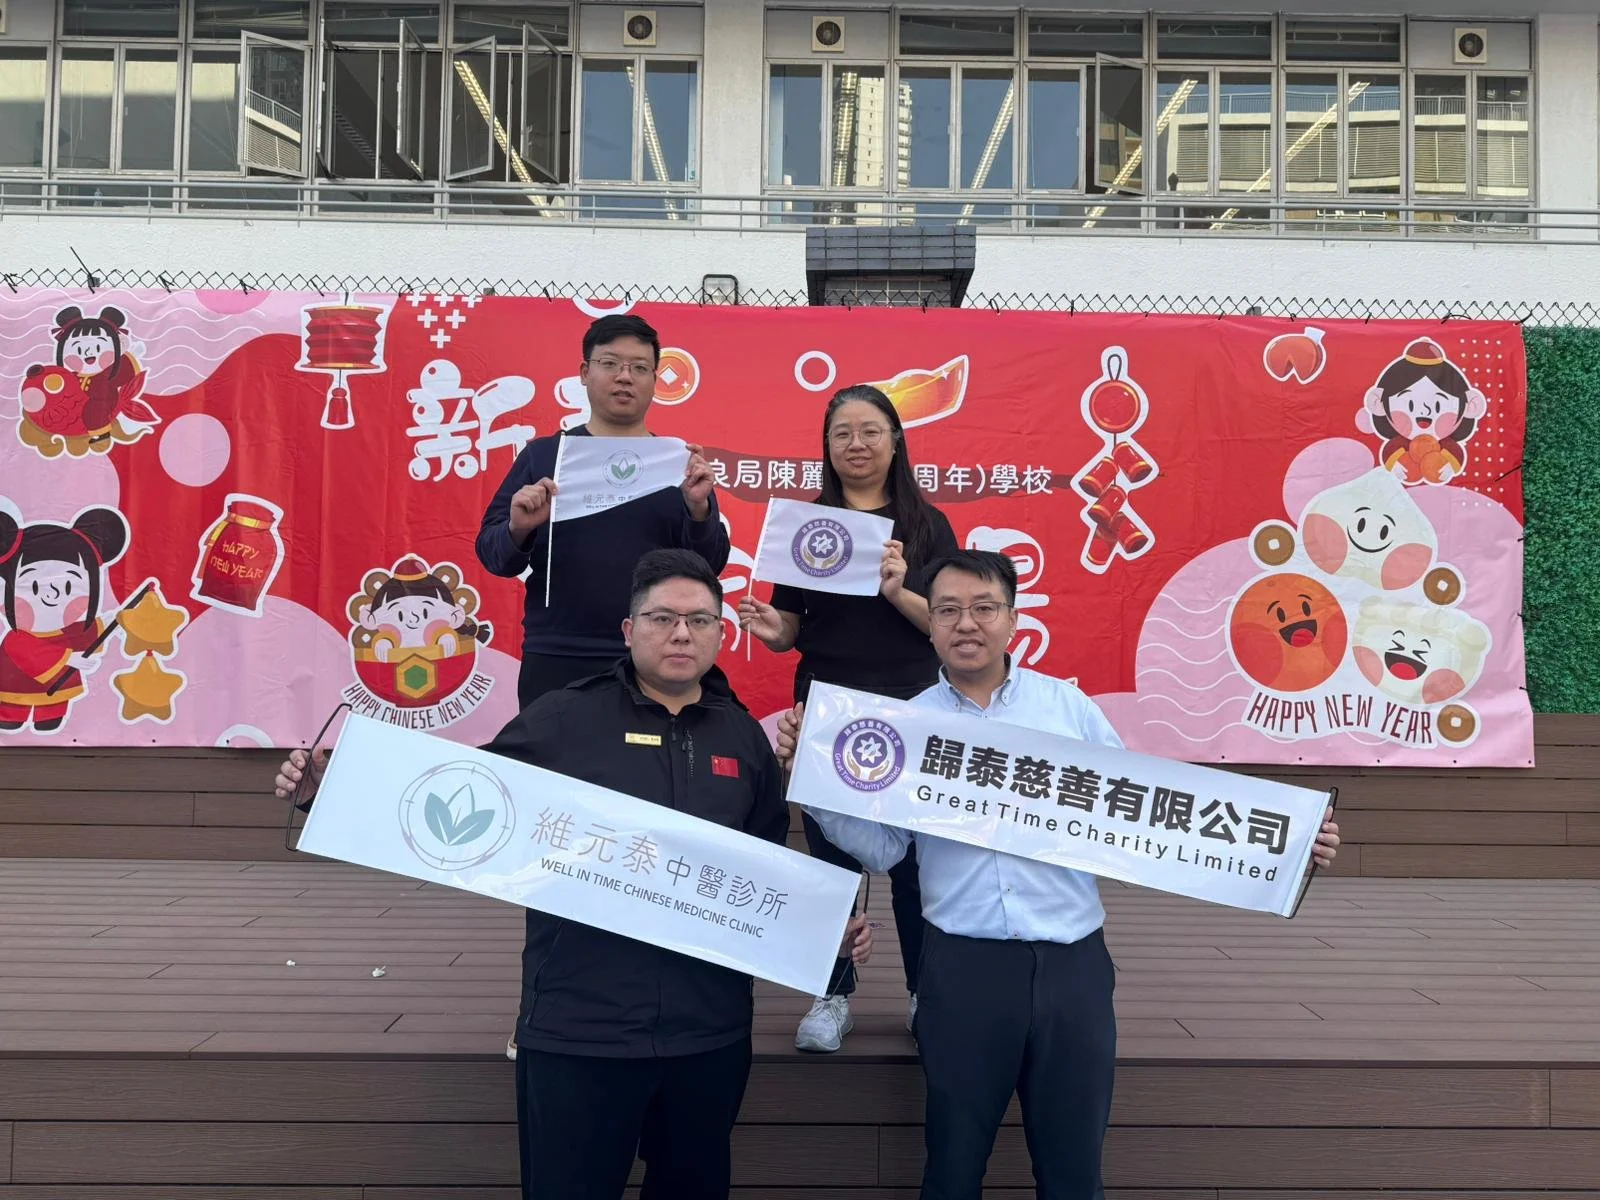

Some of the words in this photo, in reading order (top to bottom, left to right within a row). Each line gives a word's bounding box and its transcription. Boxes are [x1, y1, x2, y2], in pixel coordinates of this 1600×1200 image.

[222, 541, 260, 559] HAPPY
[230, 563, 264, 579] YEAR
[344, 683, 381, 718] HAPPY
[381, 706, 435, 729] CHINESE
[438, 697, 466, 724] NEW
[461, 673, 492, 706] YEAR
[1247, 692, 1318, 734] HAPPY
[1325, 694, 1373, 729] NEW
[1381, 701, 1432, 744] YEAR
[920, 735, 1290, 855] 歸泰慈善有限公司
[917, 785, 989, 816] Great
[997, 802, 1058, 832] Time
[1067, 819, 1169, 860] Charity
[1177, 845, 1278, 882] Limited
[541, 857, 574, 877] WELL
[576, 869, 591, 882] IN
[593, 873, 621, 893] TIME
[623, 883, 673, 908] CHINESE
[673, 899, 727, 927] MEDICINE
[728, 918, 765, 938] CLINIC
